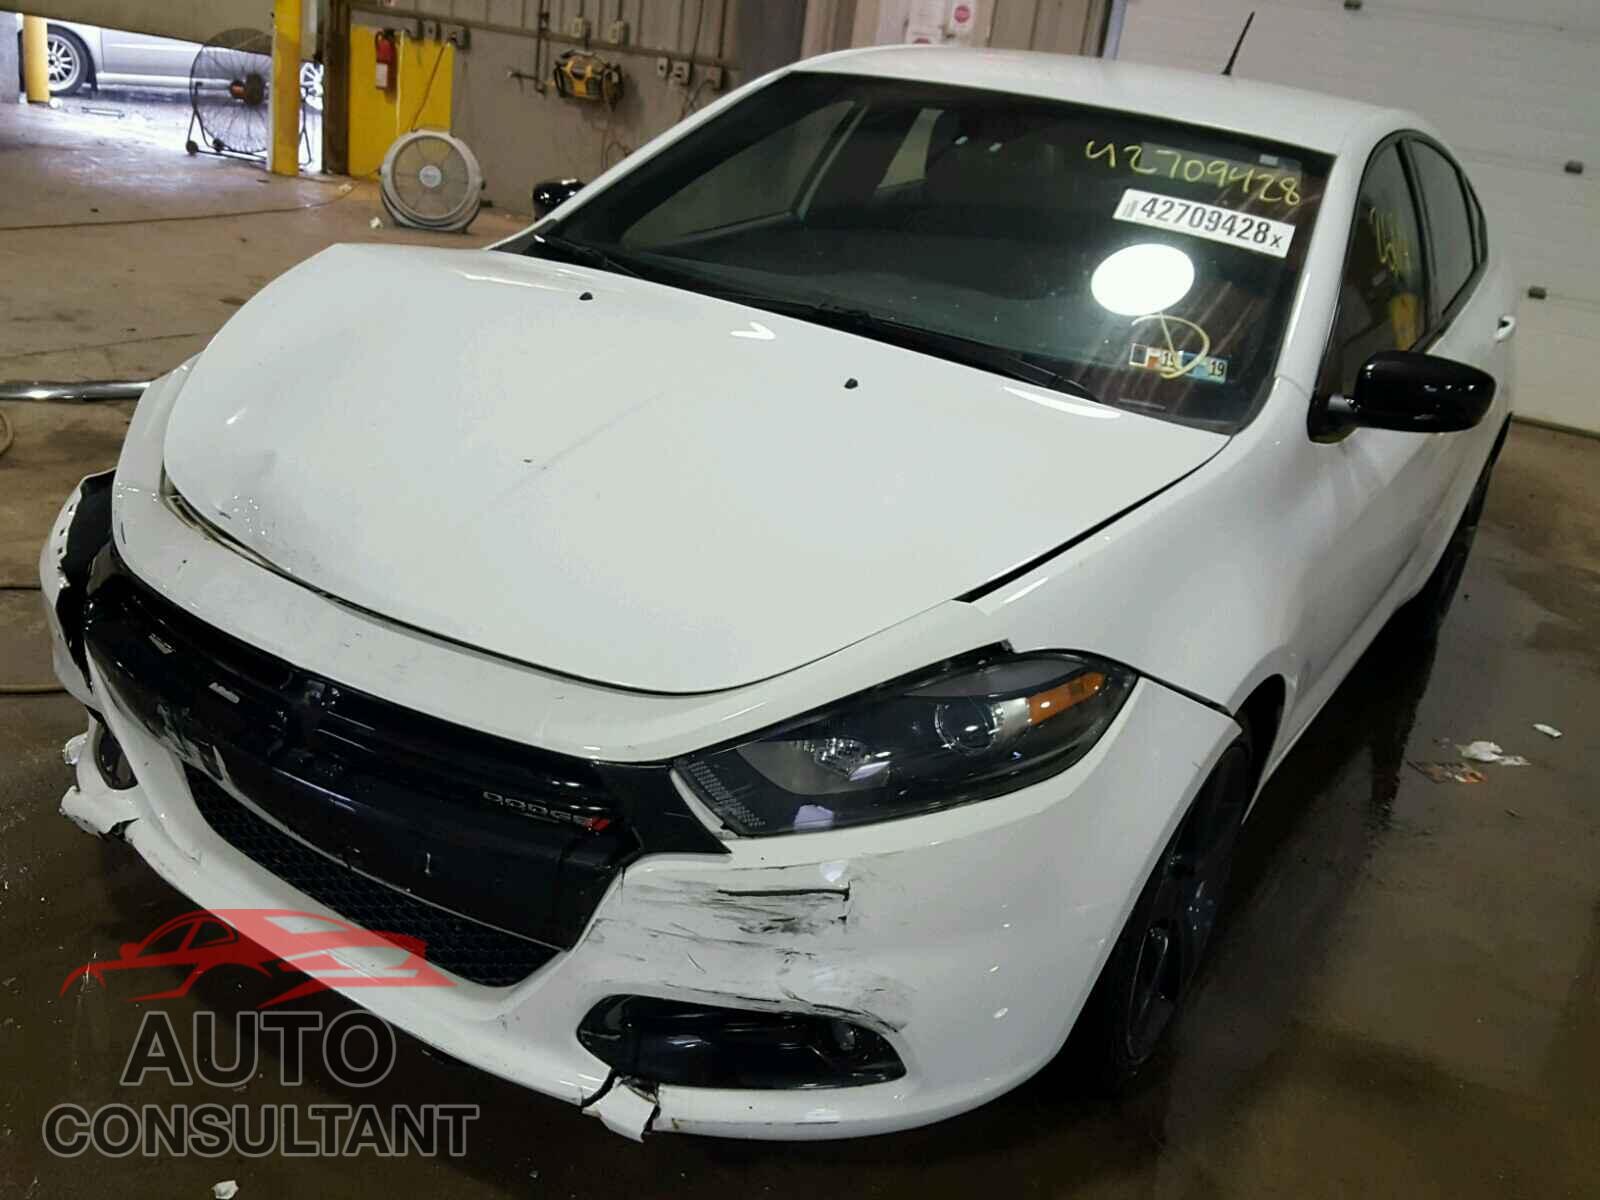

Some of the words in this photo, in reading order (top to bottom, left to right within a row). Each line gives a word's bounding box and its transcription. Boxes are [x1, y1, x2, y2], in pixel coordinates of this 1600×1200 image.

[1085, 140, 1300, 206] 42709428
[1208, 360, 1225, 377] 19
[482, 791, 593, 827] DODGE
